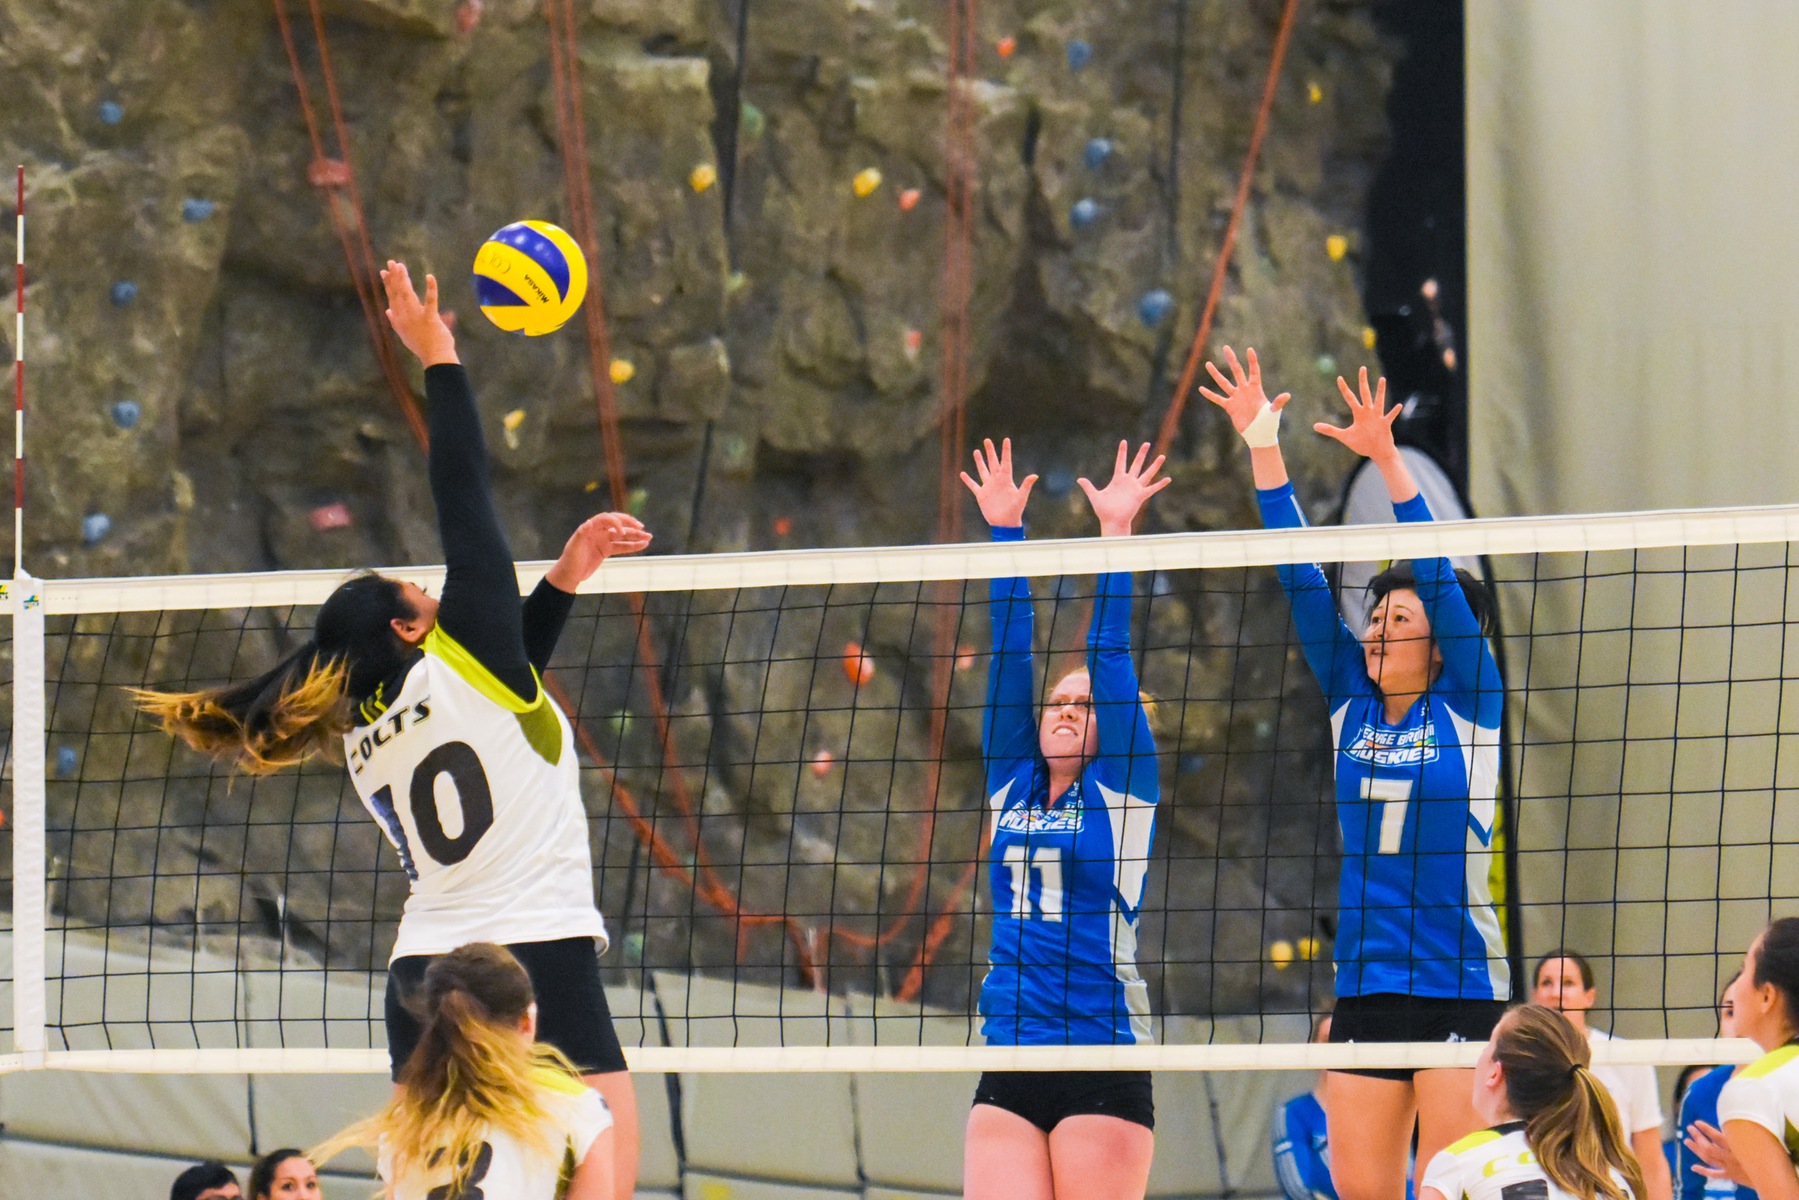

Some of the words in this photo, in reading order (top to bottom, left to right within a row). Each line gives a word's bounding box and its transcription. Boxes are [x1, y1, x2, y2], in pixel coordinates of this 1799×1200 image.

[524, 274, 550, 304] MIKASA
[349, 694, 431, 777] COLTS
[1349, 739, 1436, 765] HUSKIES
[370, 738, 494, 882] 10
[999, 810, 1083, 832] HUSKIES
[1360, 777, 1413, 854] 7
[1002, 845, 1063, 923] 11
